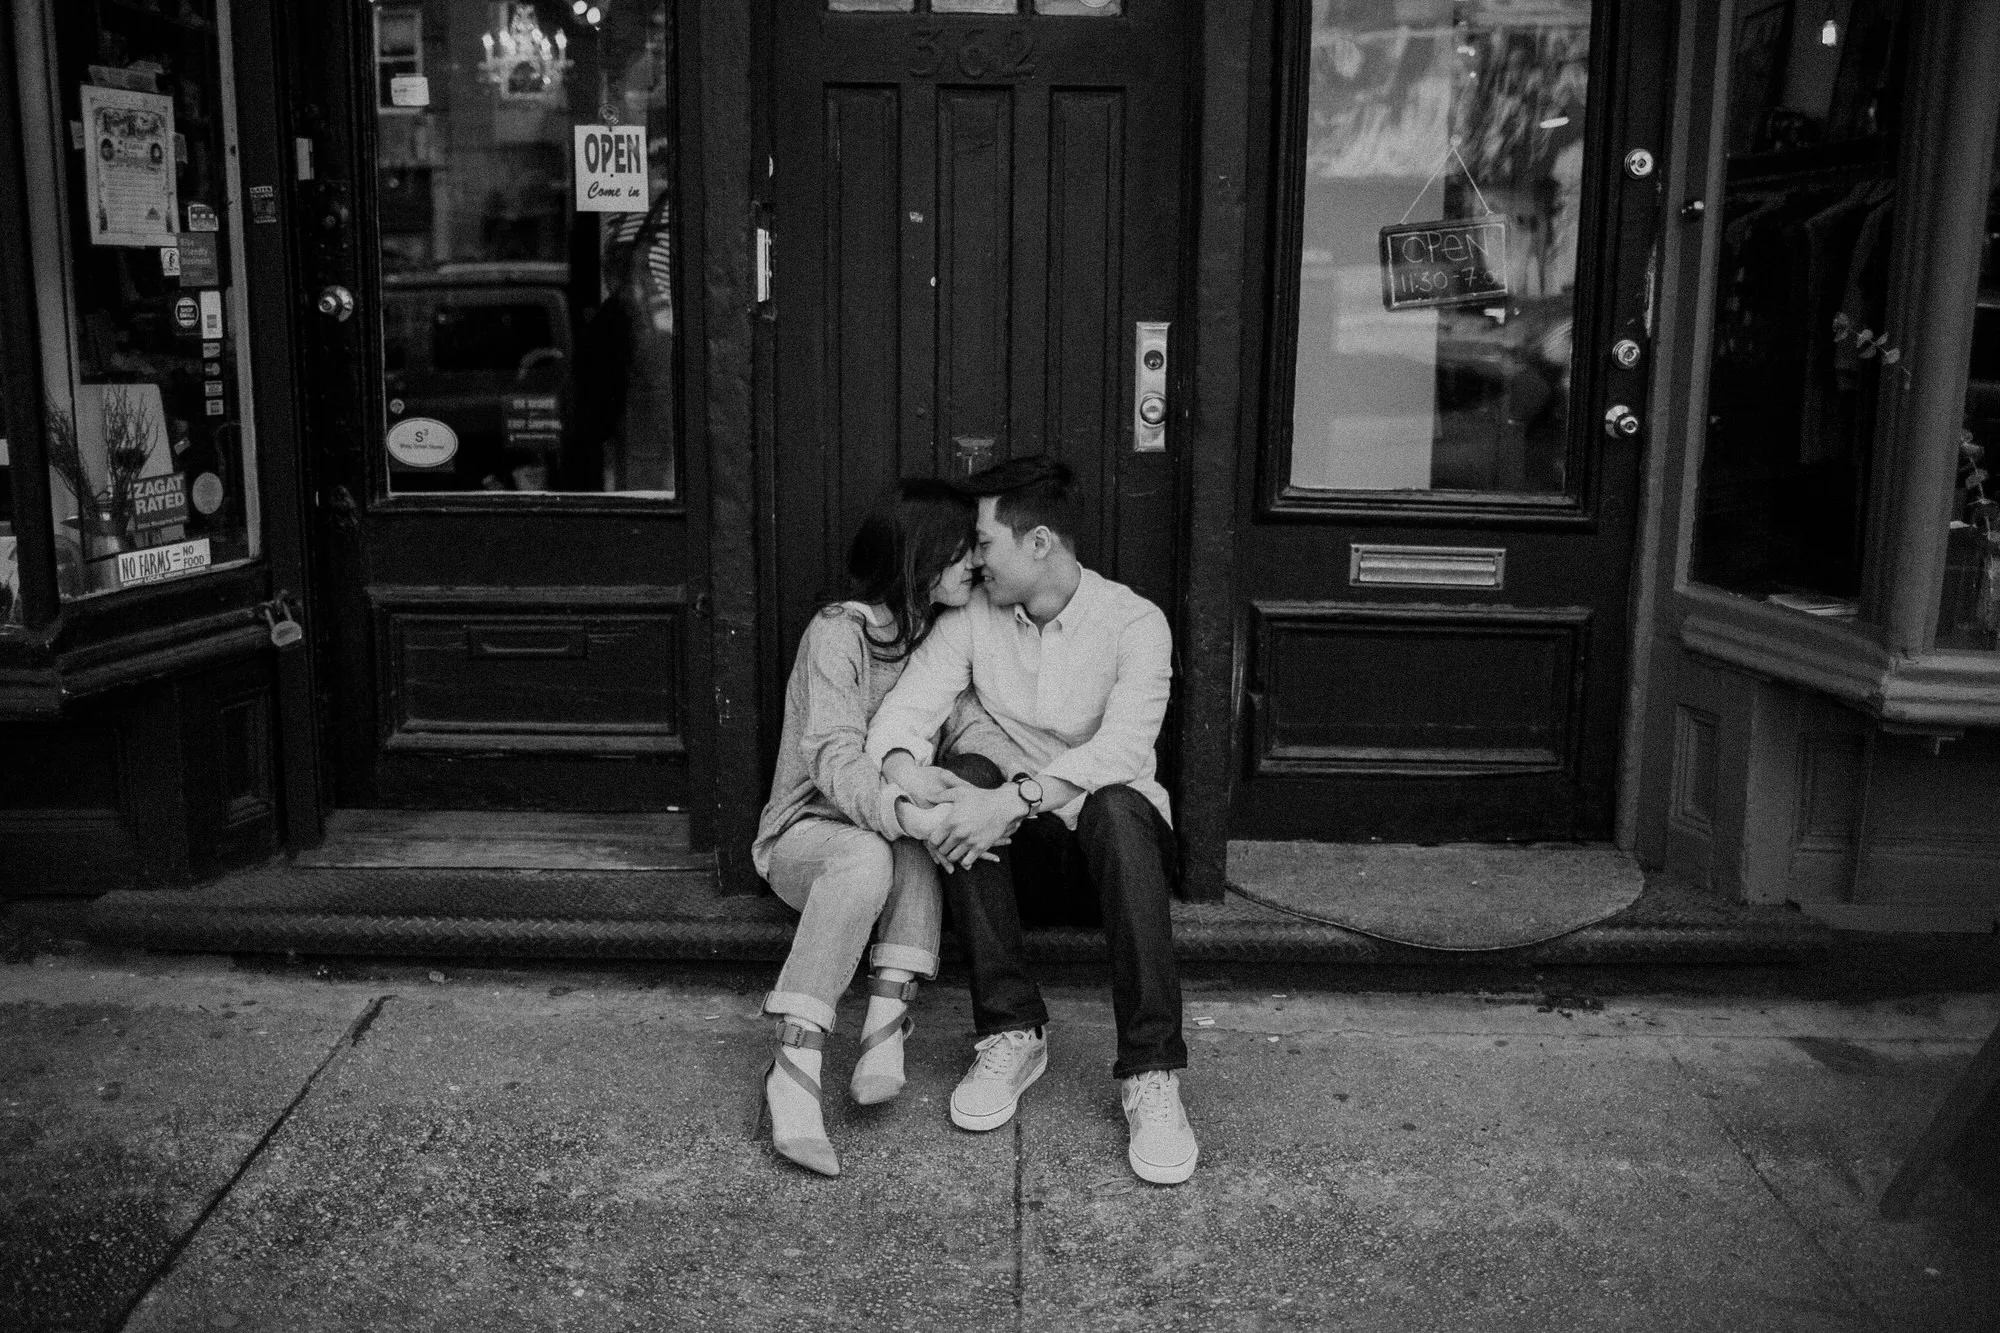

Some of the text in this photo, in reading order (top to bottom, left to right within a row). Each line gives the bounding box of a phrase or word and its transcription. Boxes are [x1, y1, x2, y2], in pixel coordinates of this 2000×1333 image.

[909, 28, 1036, 79] 362
[584, 134, 641, 174] OPEN
[587, 181, 641, 199] Come in
[133, 474, 184, 499] ZAGAT
[135, 492, 185, 515] RATED
[121, 557, 136, 580] NO
[139, 550, 171, 577] FARMS
[182, 545, 194, 556] NO
[183, 555, 205, 567] FOOD
